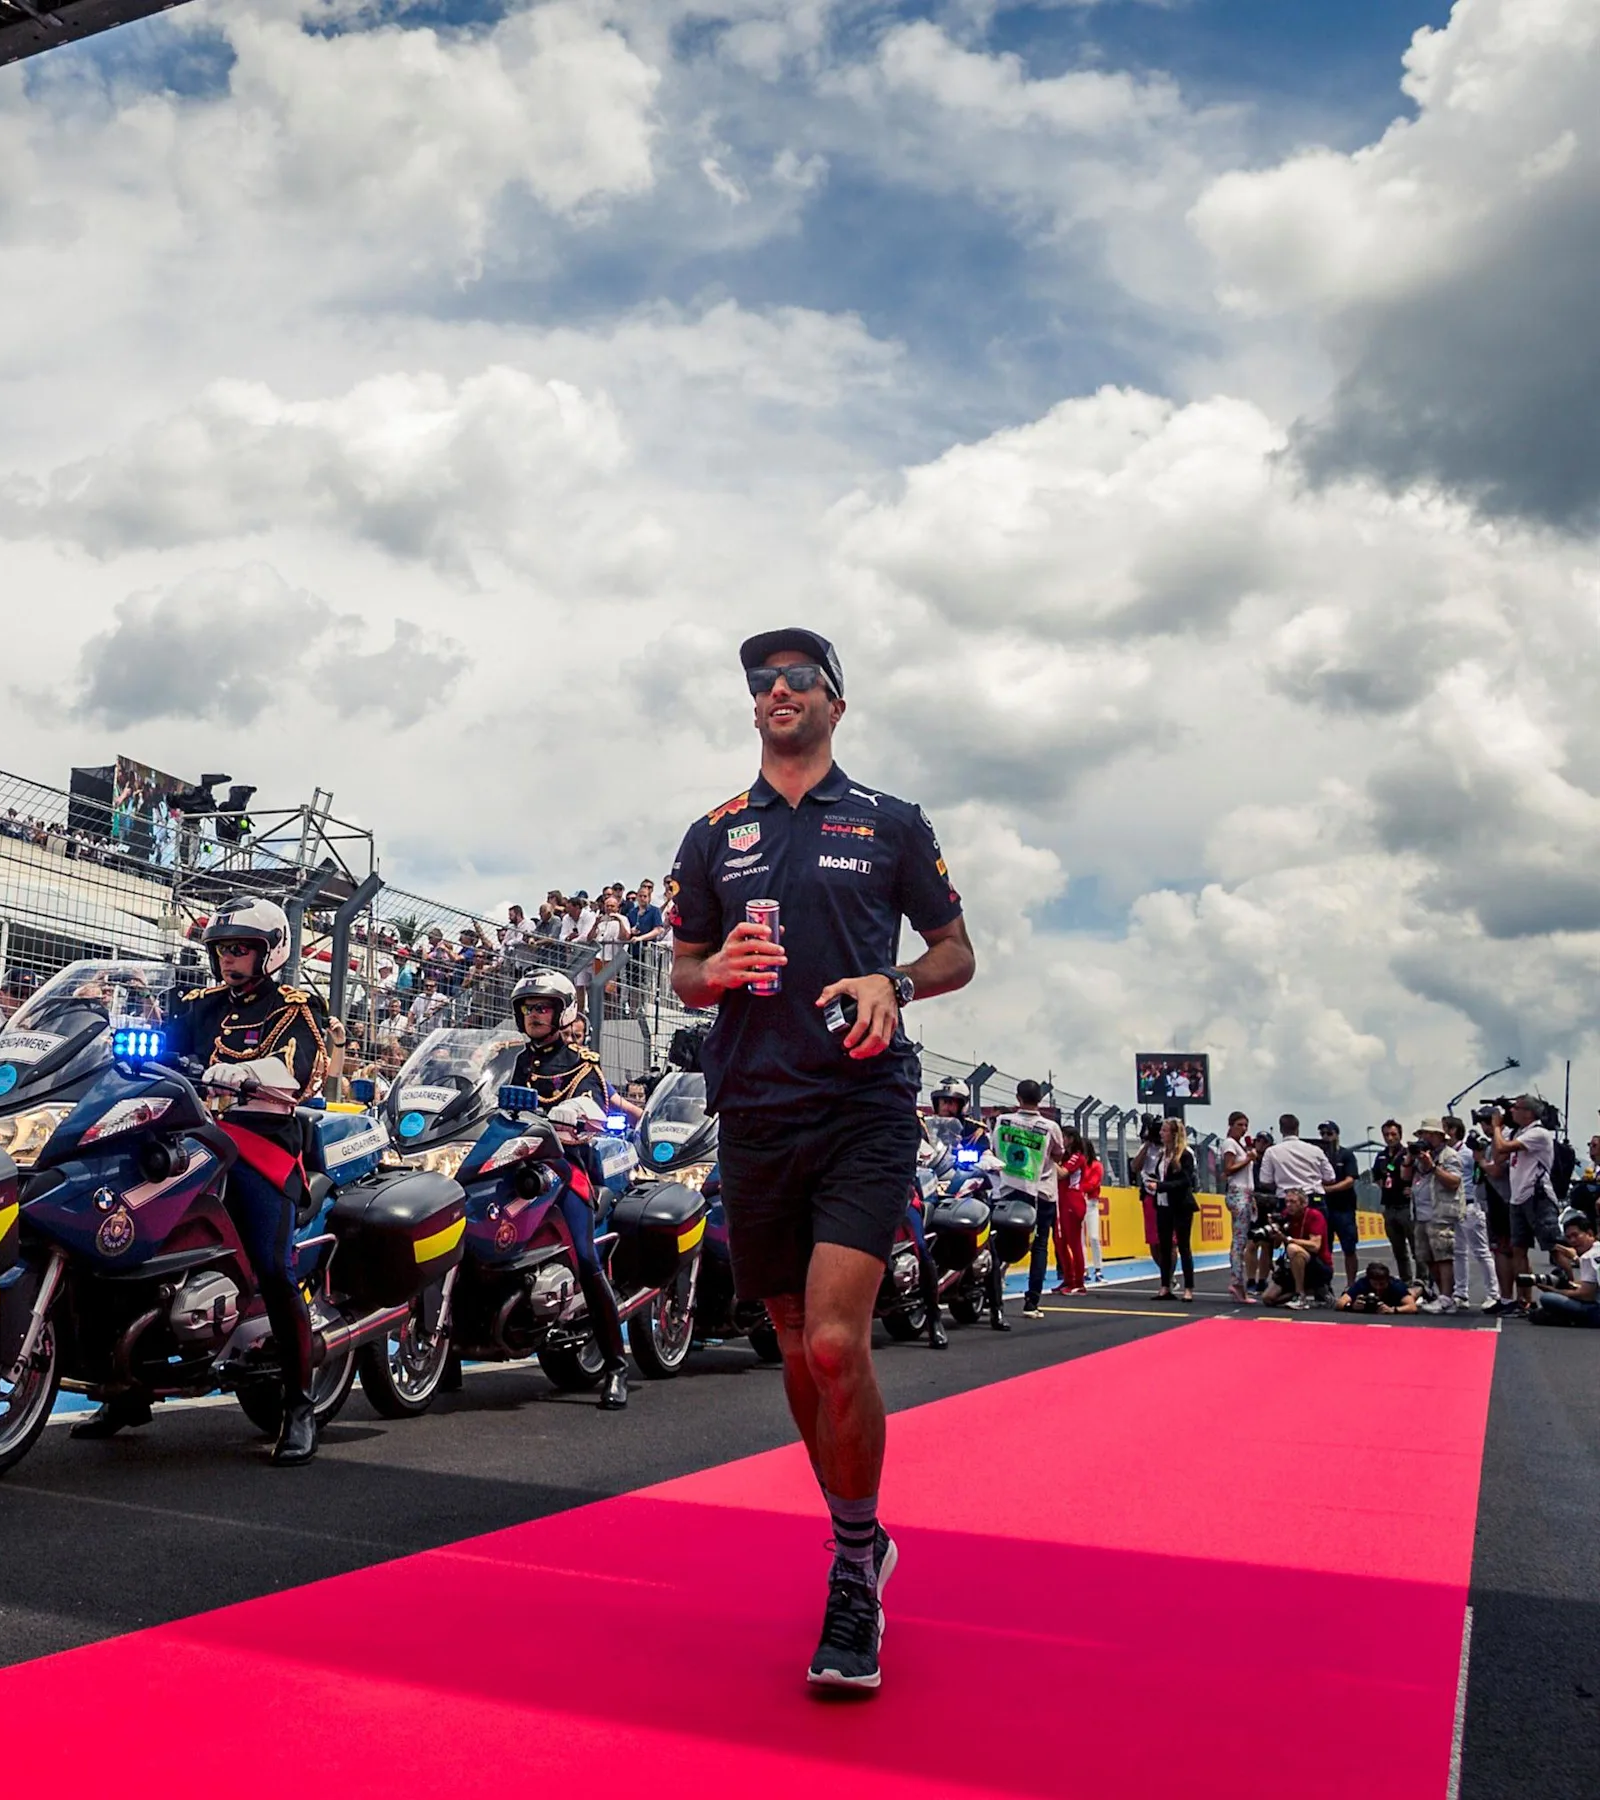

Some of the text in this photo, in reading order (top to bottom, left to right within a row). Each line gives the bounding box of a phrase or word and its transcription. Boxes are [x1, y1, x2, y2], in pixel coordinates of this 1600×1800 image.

[730, 823, 758, 839] TAG
[818, 855, 857, 871] Mobil
[721, 864, 770, 882] ASTON MARTIN
